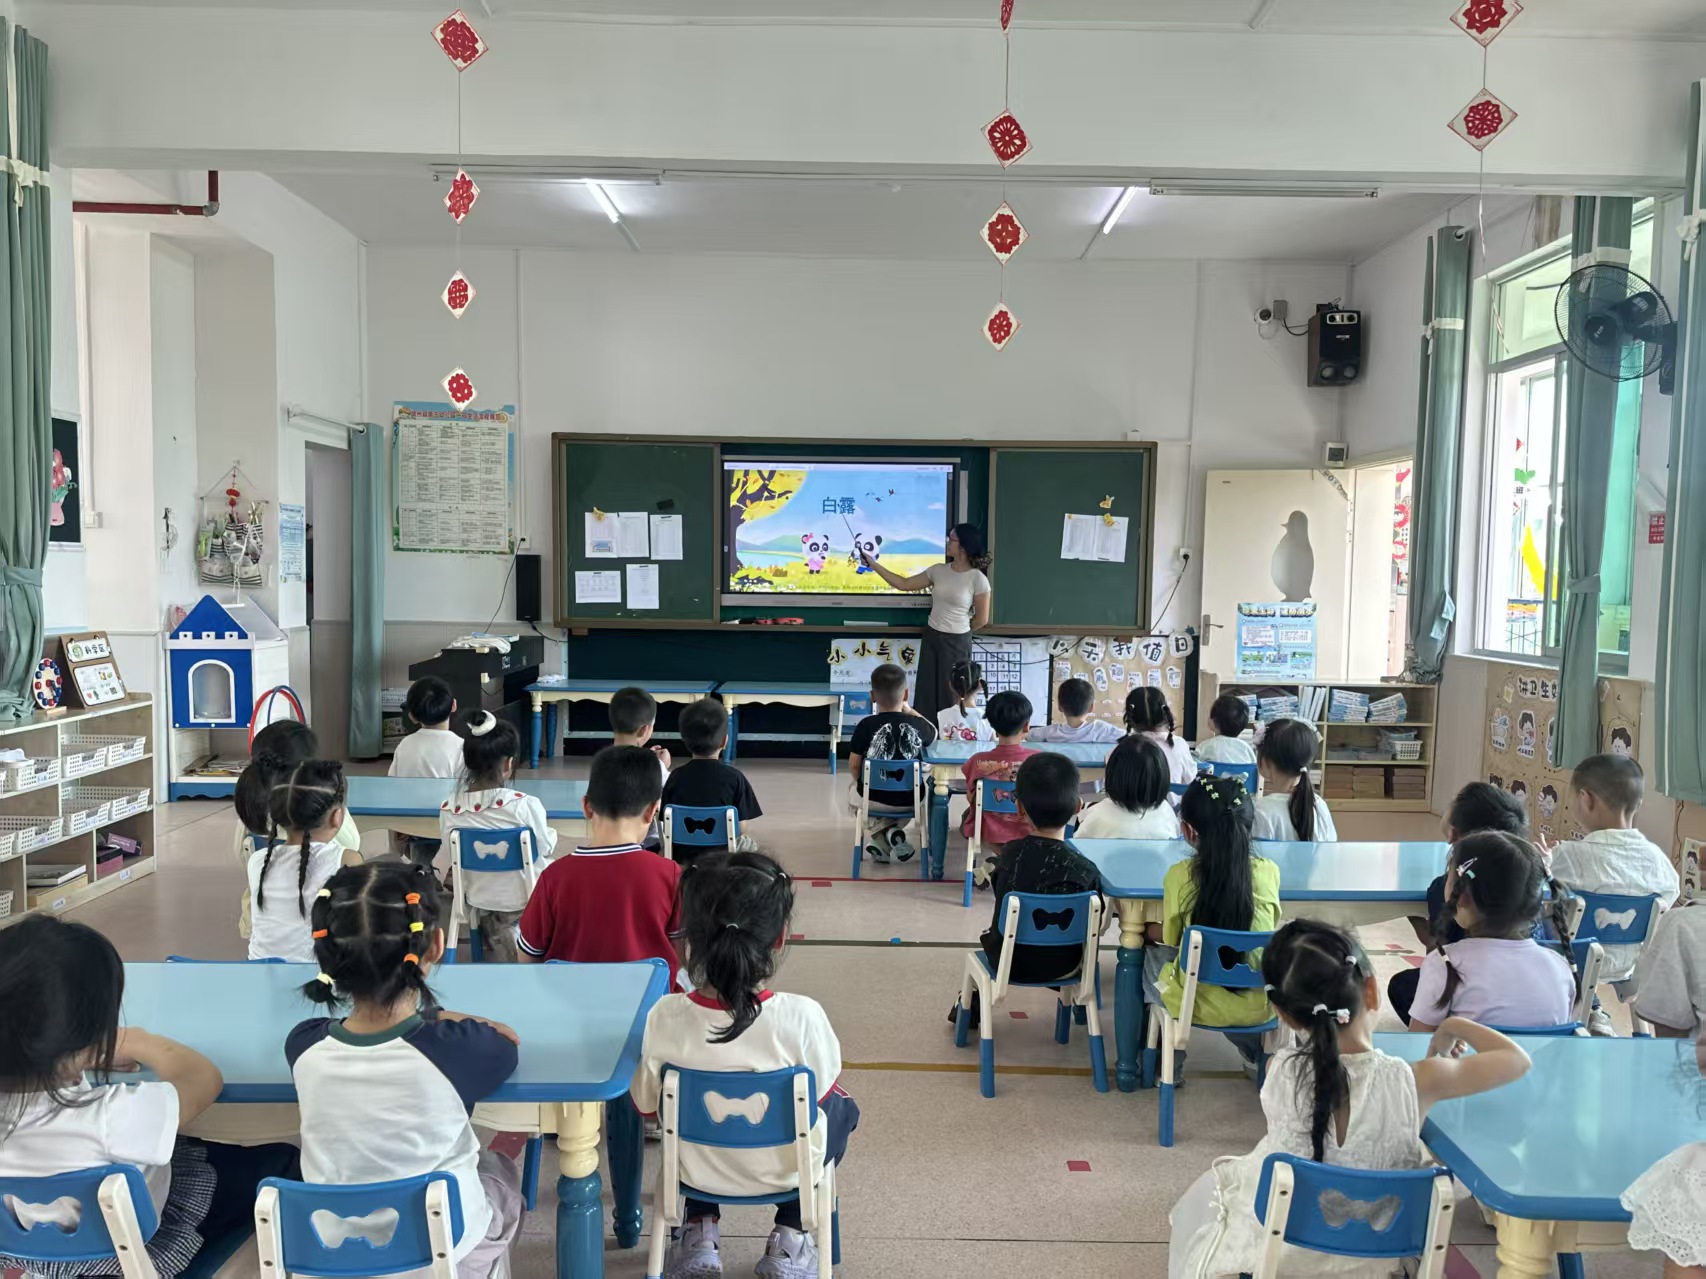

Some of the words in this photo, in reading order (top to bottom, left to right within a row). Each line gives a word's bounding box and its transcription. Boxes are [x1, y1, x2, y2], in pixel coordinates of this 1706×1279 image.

[822, 496, 856, 514] 白露
[85, 643, 105, 654] 科学区
[1052, 636, 1188, 662] 今天我值日
